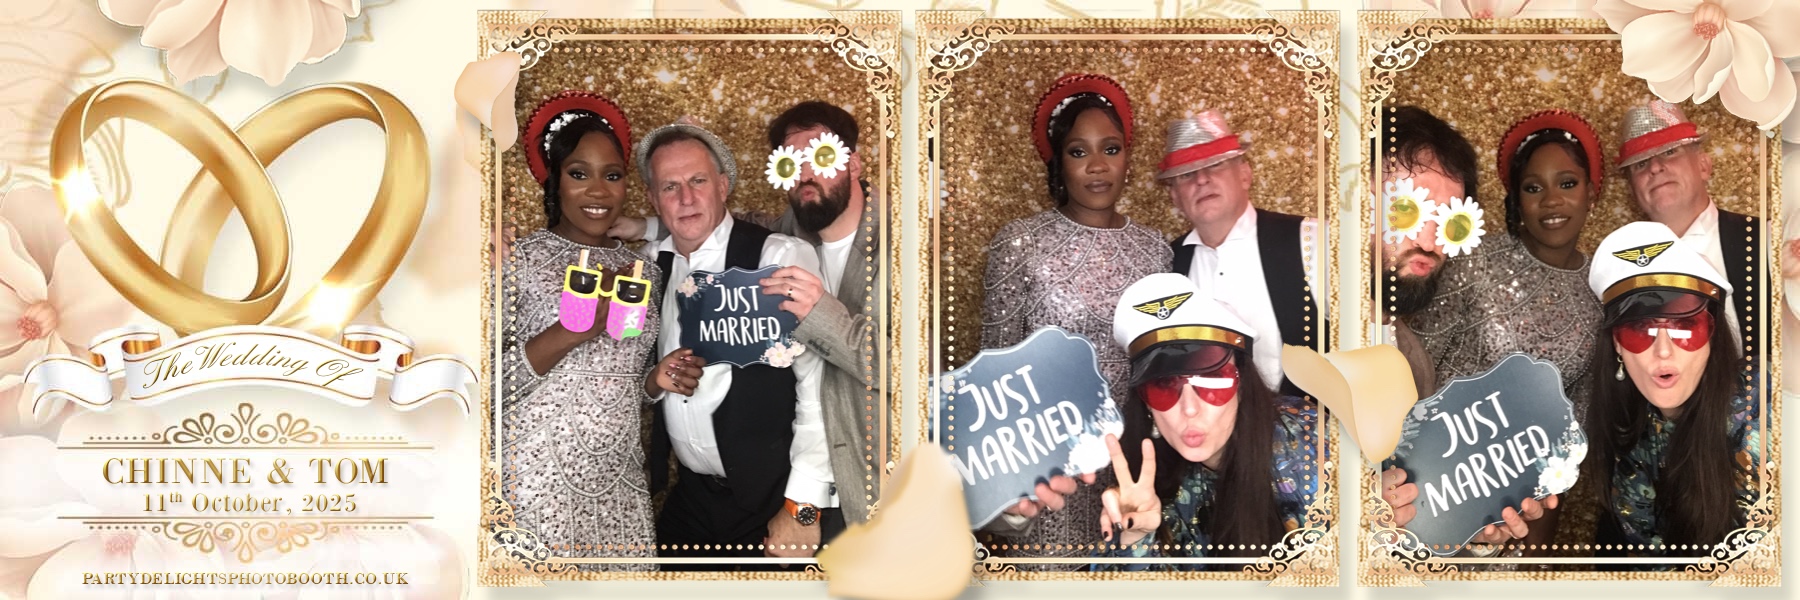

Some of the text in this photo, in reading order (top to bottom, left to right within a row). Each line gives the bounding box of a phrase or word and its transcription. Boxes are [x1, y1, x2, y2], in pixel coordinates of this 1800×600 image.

[699, 316, 781, 348] MARRIED
[713, 284, 760, 314] JUST
[957, 364, 1041, 433] JUST
[1430, 391, 1509, 458] JUST
[952, 400, 1083, 486] MARRIED
[1423, 425, 1549, 517] MARRIED
